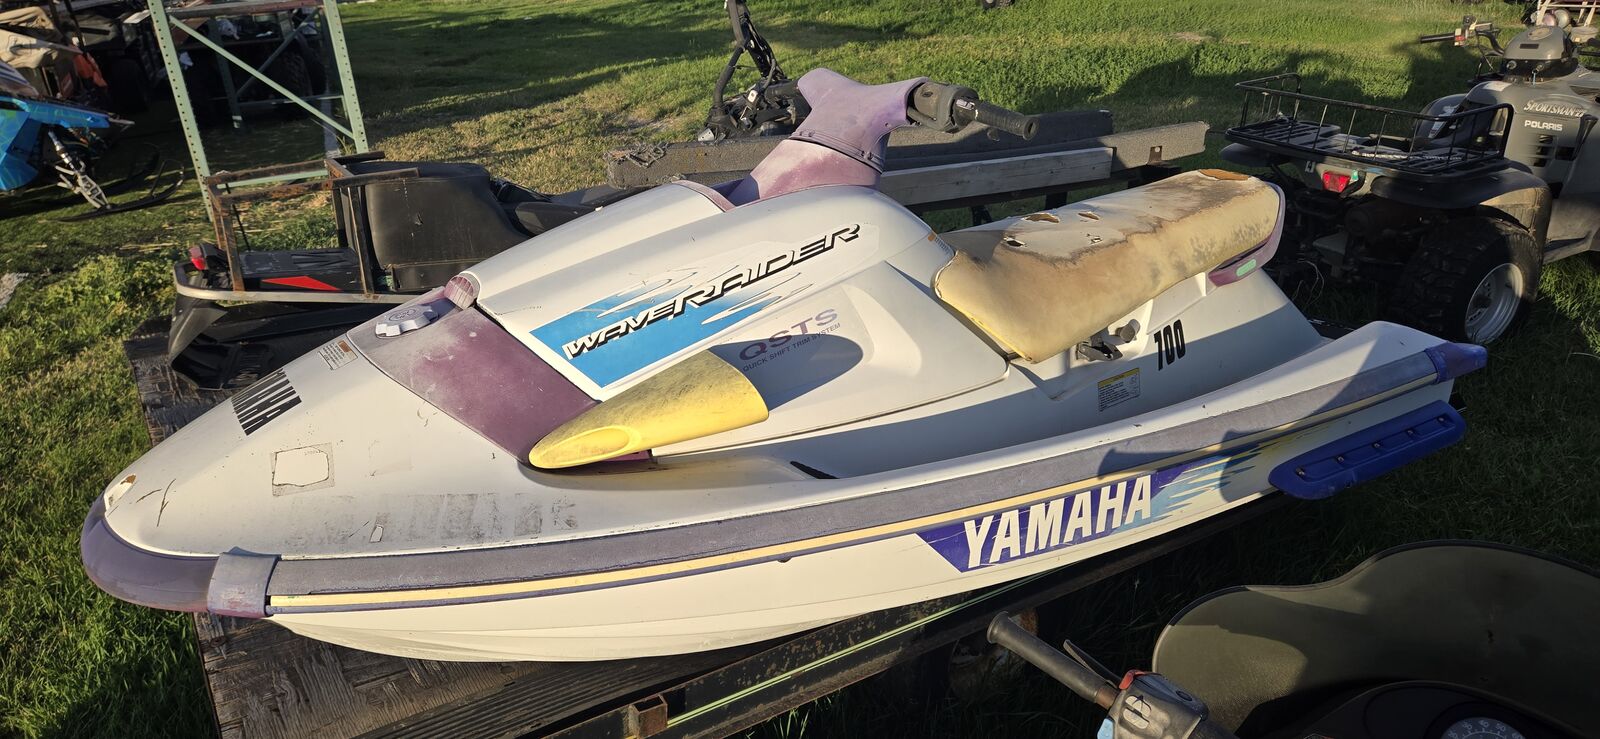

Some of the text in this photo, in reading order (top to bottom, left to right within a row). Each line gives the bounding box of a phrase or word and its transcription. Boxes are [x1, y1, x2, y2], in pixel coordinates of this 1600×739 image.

[1523, 100, 1575, 116] SPORTSMAN
[1524, 120, 1563, 131] POLARIS
[561, 223, 861, 360] WAVERAIDER
[739, 308, 838, 361] QSTS
[743, 322, 841, 372] QUICK SHIFT TRIM SYSTEM
[1153, 319, 1187, 371] 700
[963, 475, 1152, 569] YAMAHA
